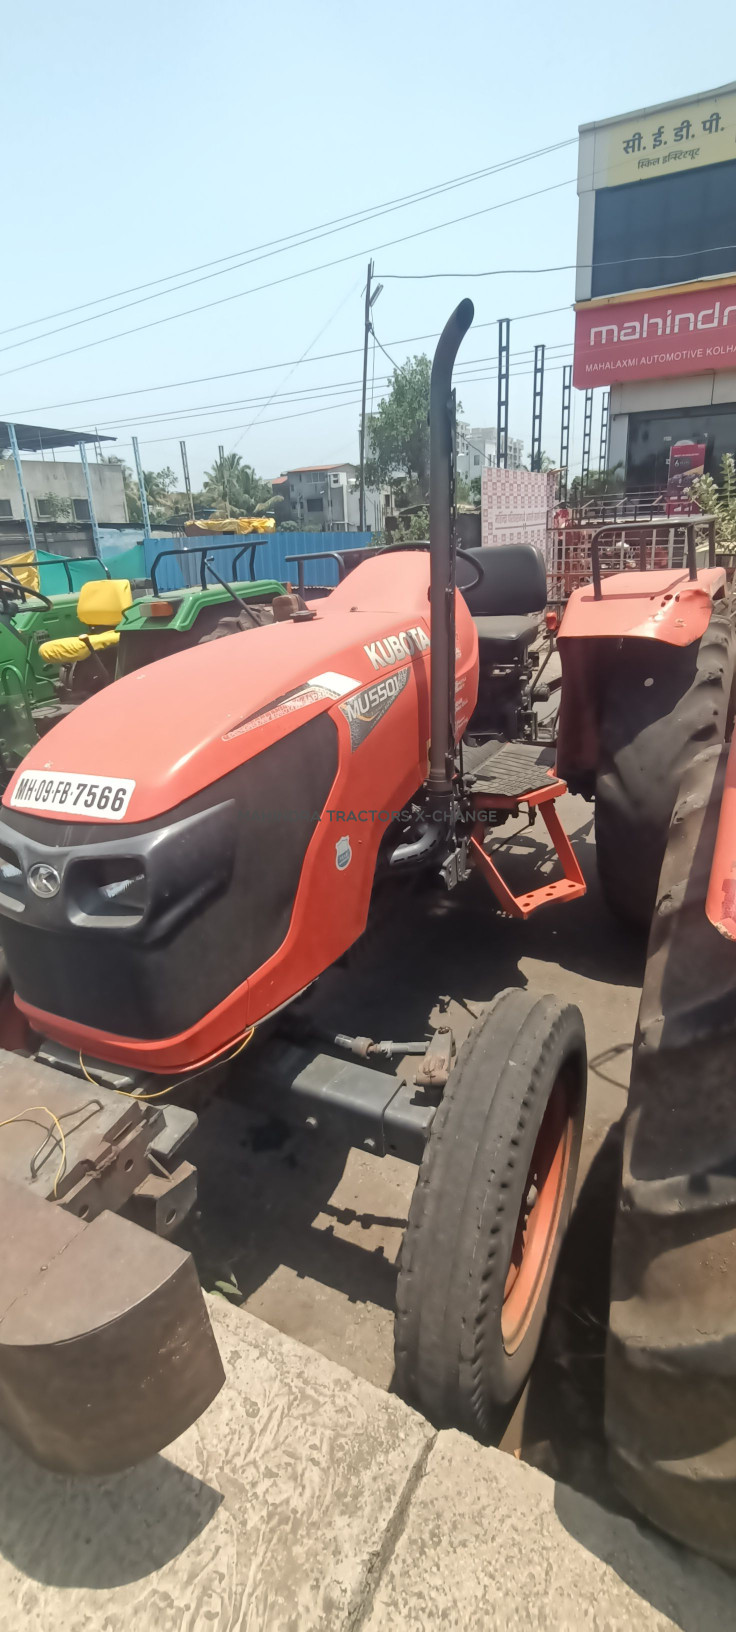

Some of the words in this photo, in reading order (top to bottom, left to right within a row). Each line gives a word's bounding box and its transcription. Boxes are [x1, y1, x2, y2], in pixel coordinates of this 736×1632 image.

[585, 357, 638, 372] MAHALAXMI
[640, 348, 703, 364] AUTOMOTIVE
[363, 626, 431, 671] KUBOTA
[347, 676, 400, 722] MU5501
